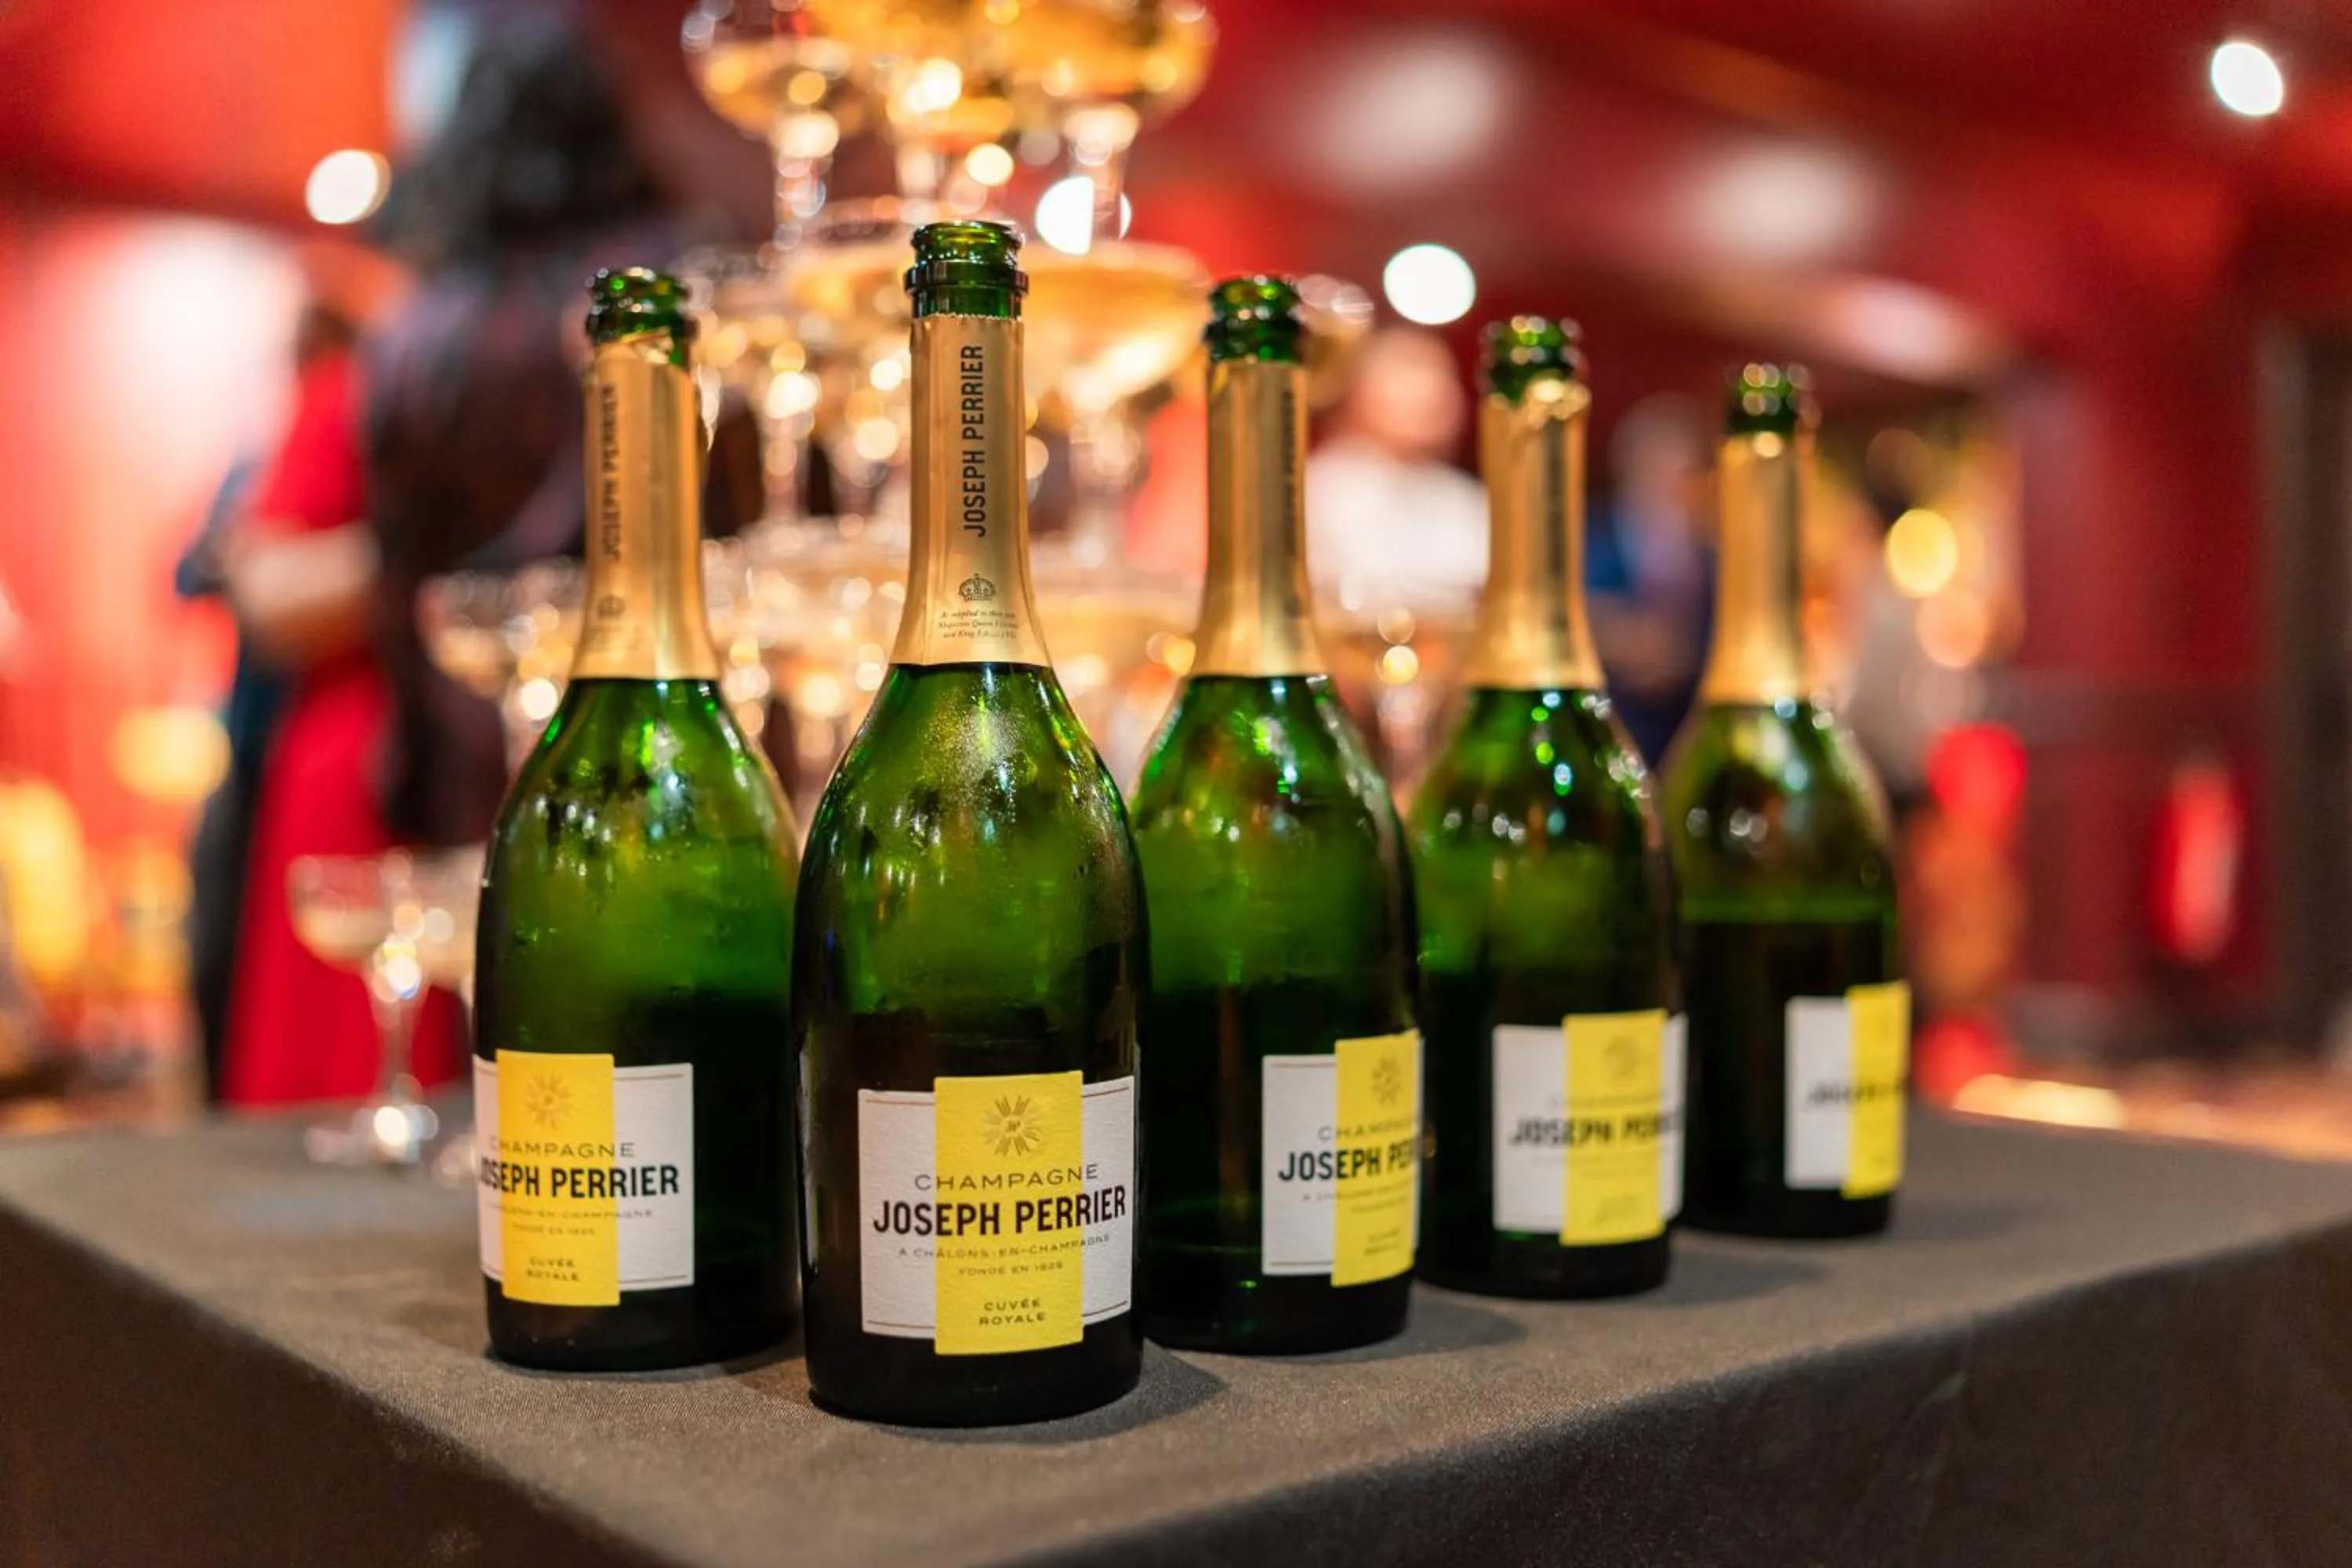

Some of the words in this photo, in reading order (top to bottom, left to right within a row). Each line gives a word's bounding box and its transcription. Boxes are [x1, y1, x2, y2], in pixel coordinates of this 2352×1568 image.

[960, 345, 985, 441] PERRIER
[963, 451, 986, 538] JOSEPH
[489, 1134, 636, 1160] CHAMPAGNE
[1279, 1146, 1382, 1182] JOSEPH
[480, 1156, 540, 1197] OSEPH
[551, 1165, 680, 1199] PERRIER
[914, 1163, 1098, 1192] CHAMPAGNE
[873, 1199, 1001, 1236] JOSEPH
[1015, 1185, 1127, 1233] PERRIER
[978, 1312, 1046, 1327] ROYALE
[983, 1298, 1041, 1311] CUVÉE
